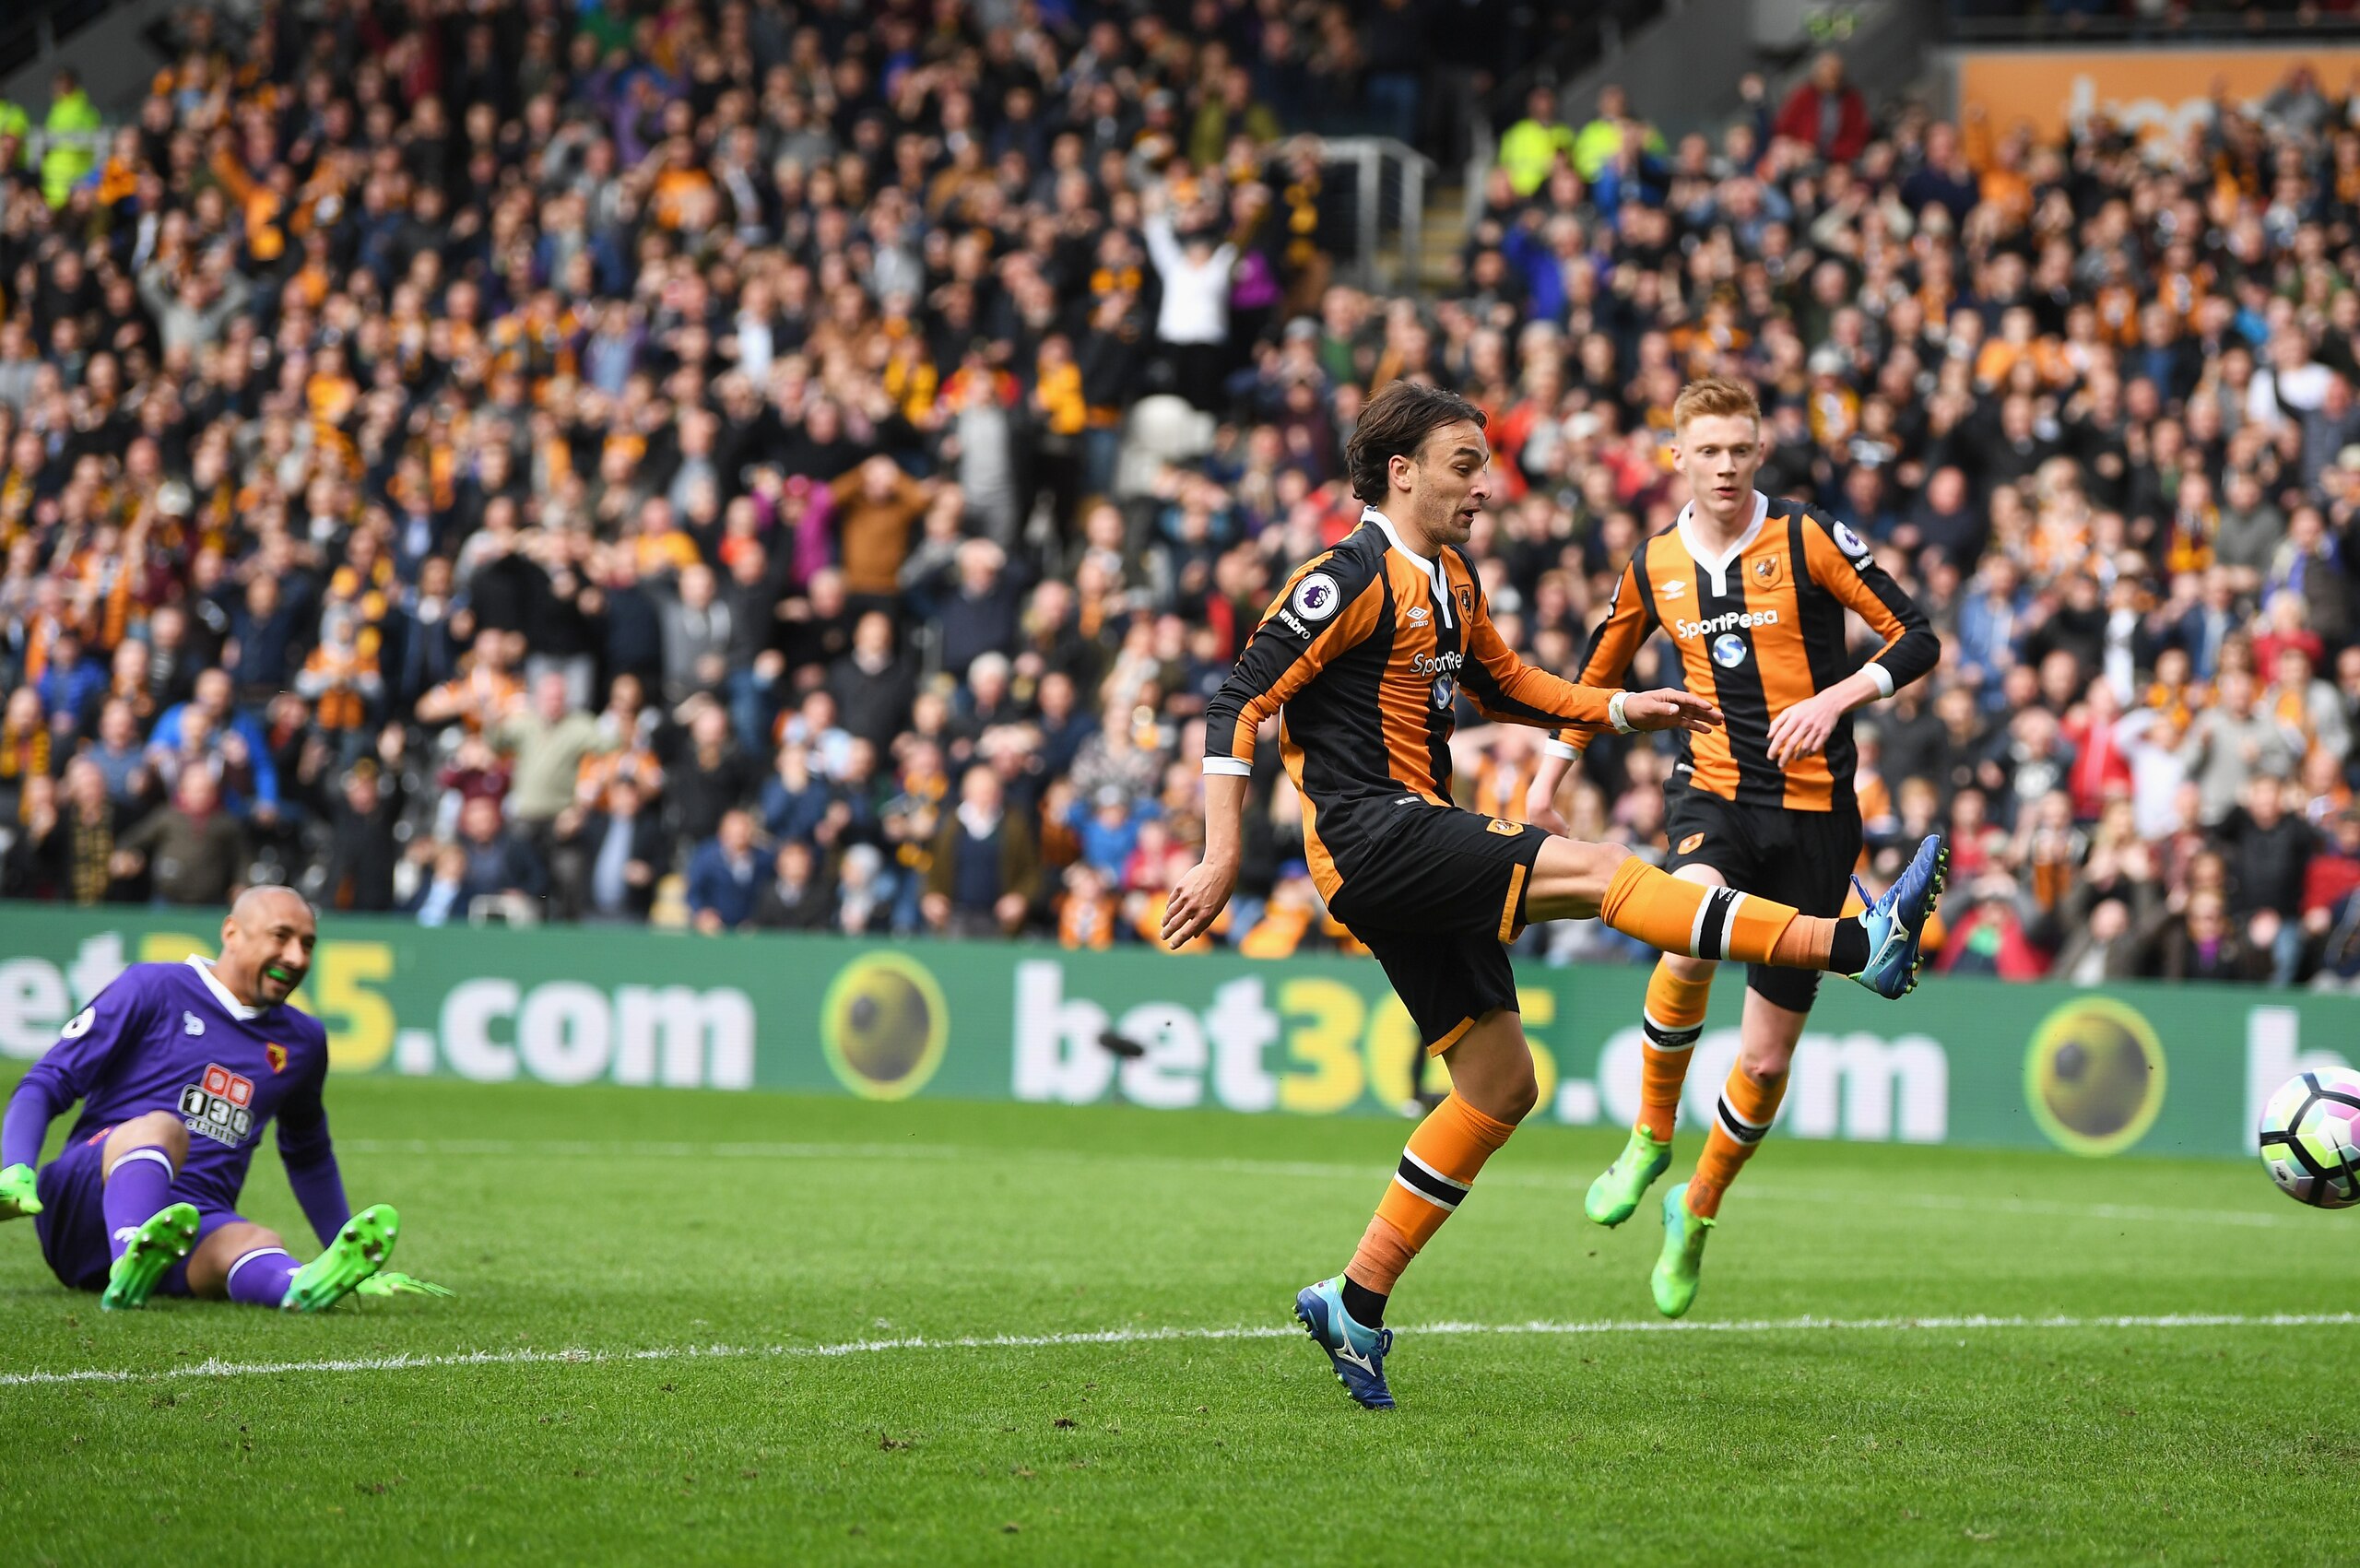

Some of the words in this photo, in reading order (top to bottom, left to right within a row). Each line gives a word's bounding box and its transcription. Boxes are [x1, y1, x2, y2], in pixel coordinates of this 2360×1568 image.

[1279, 608, 1311, 640] umbro
[1410, 619, 1429, 629] umbro
[1675, 609, 1779, 640] SportPesa
[1410, 651, 1465, 678] SportPe
[186, 1090, 252, 1137] 138
